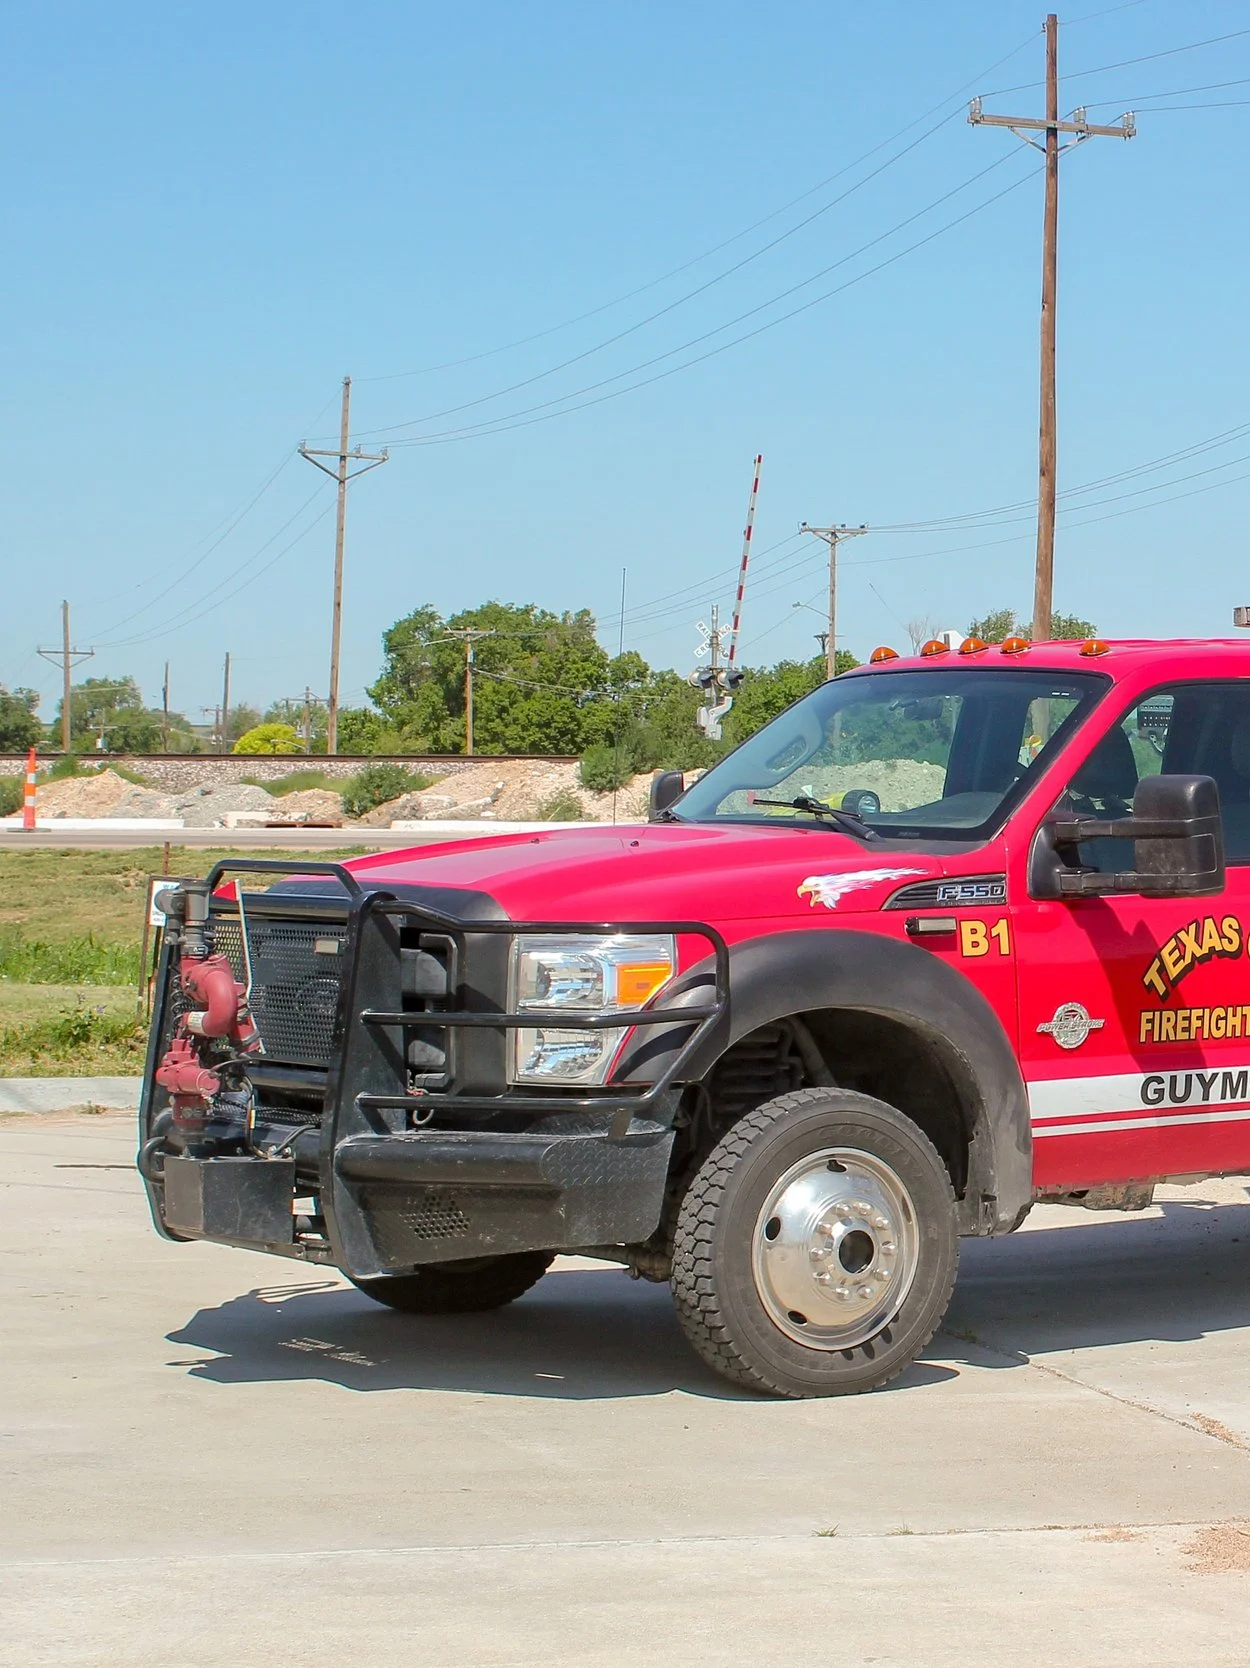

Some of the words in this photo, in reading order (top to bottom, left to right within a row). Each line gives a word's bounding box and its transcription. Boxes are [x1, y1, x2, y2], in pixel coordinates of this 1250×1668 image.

[695, 624, 731, 657] CROING
[937, 883, 1005, 901] F-550
[960, 918, 1010, 957] B1
[1142, 915, 1242, 1002] TEXAS
